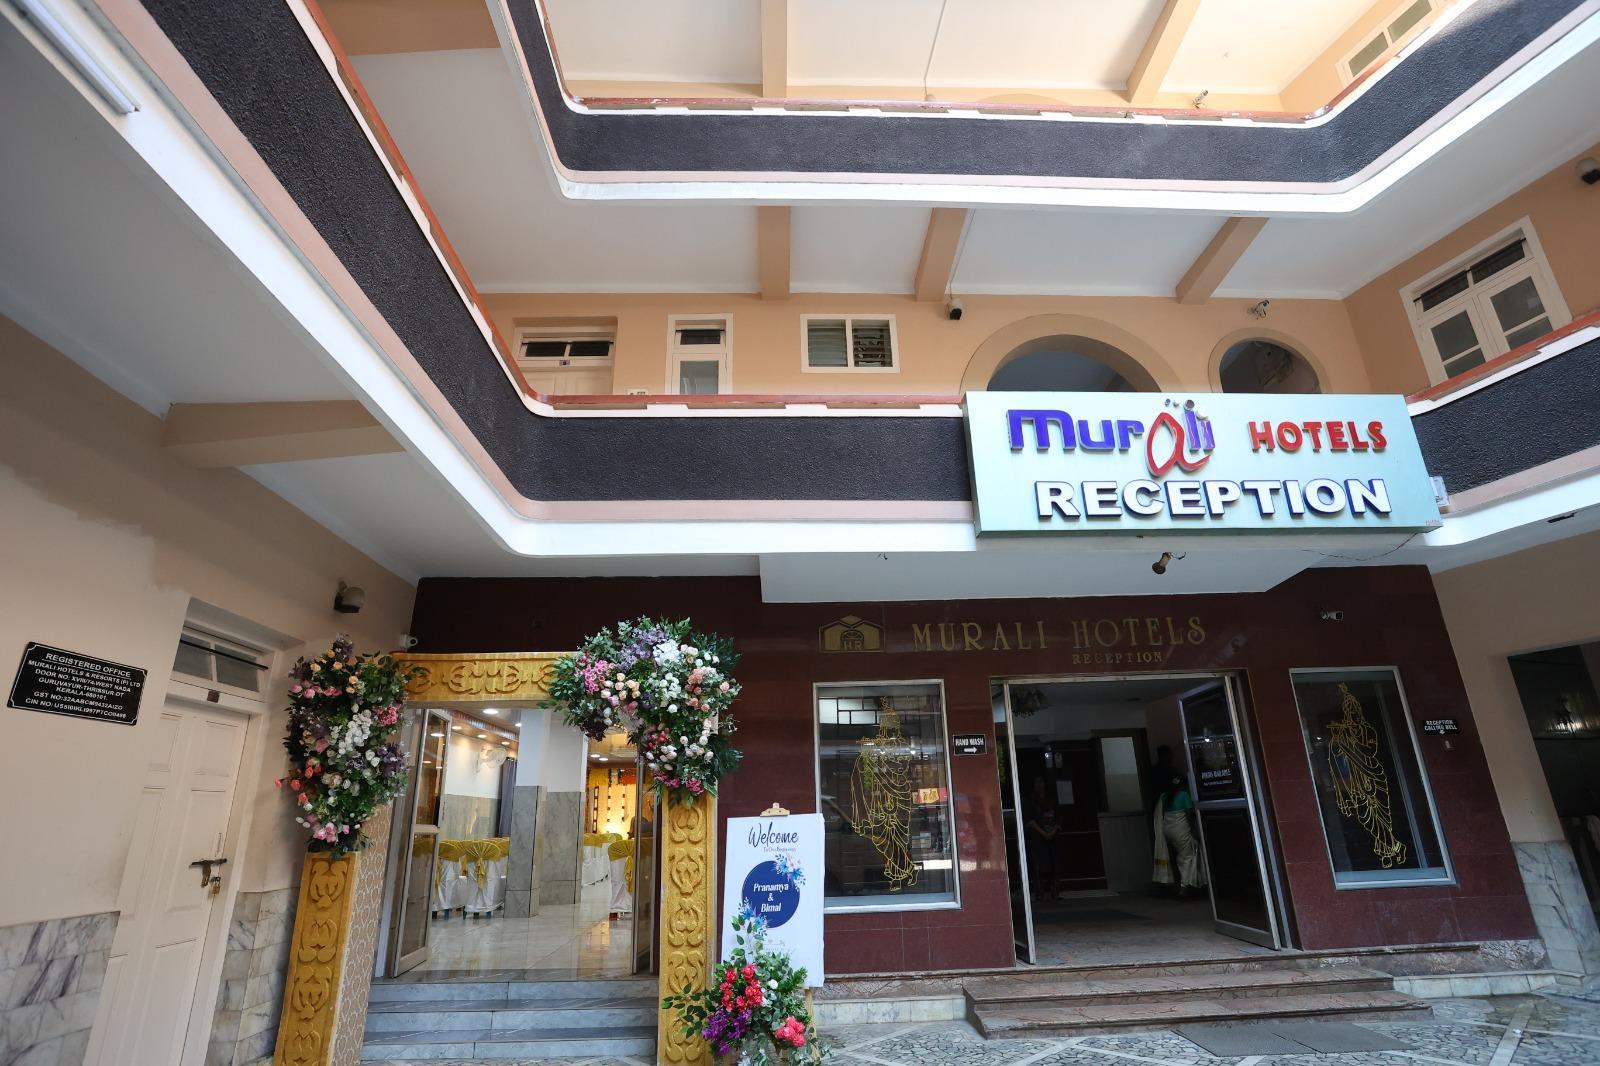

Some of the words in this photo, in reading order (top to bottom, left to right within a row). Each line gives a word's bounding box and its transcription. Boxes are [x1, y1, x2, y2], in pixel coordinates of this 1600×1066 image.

[1248, 420, 1388, 453] HOTELS
[1034, 478, 1393, 522] RECEPTION
[911, 620, 1048, 652] MURALI
[1071, 617, 1207, 649] HOTELS
[45, 653, 101, 671] REGISTERED
[103, 666, 131, 678] OFFICE
[1072, 651, 1163, 665] RECEPTION
[28, 660, 57, 670] MURALI
[57, 666, 83, 676] HOTELS
[91, 673, 120, 684] RESORTS
[35, 668, 57, 678] DOOR
[114, 684, 131, 693] NADA
[25, 697, 39, 705] CIN
[33, 691, 49, 699] GST
[748, 821, 800, 848] Welcome
[753, 883, 789, 893] Pranamya
[767, 892, 774, 901] &
